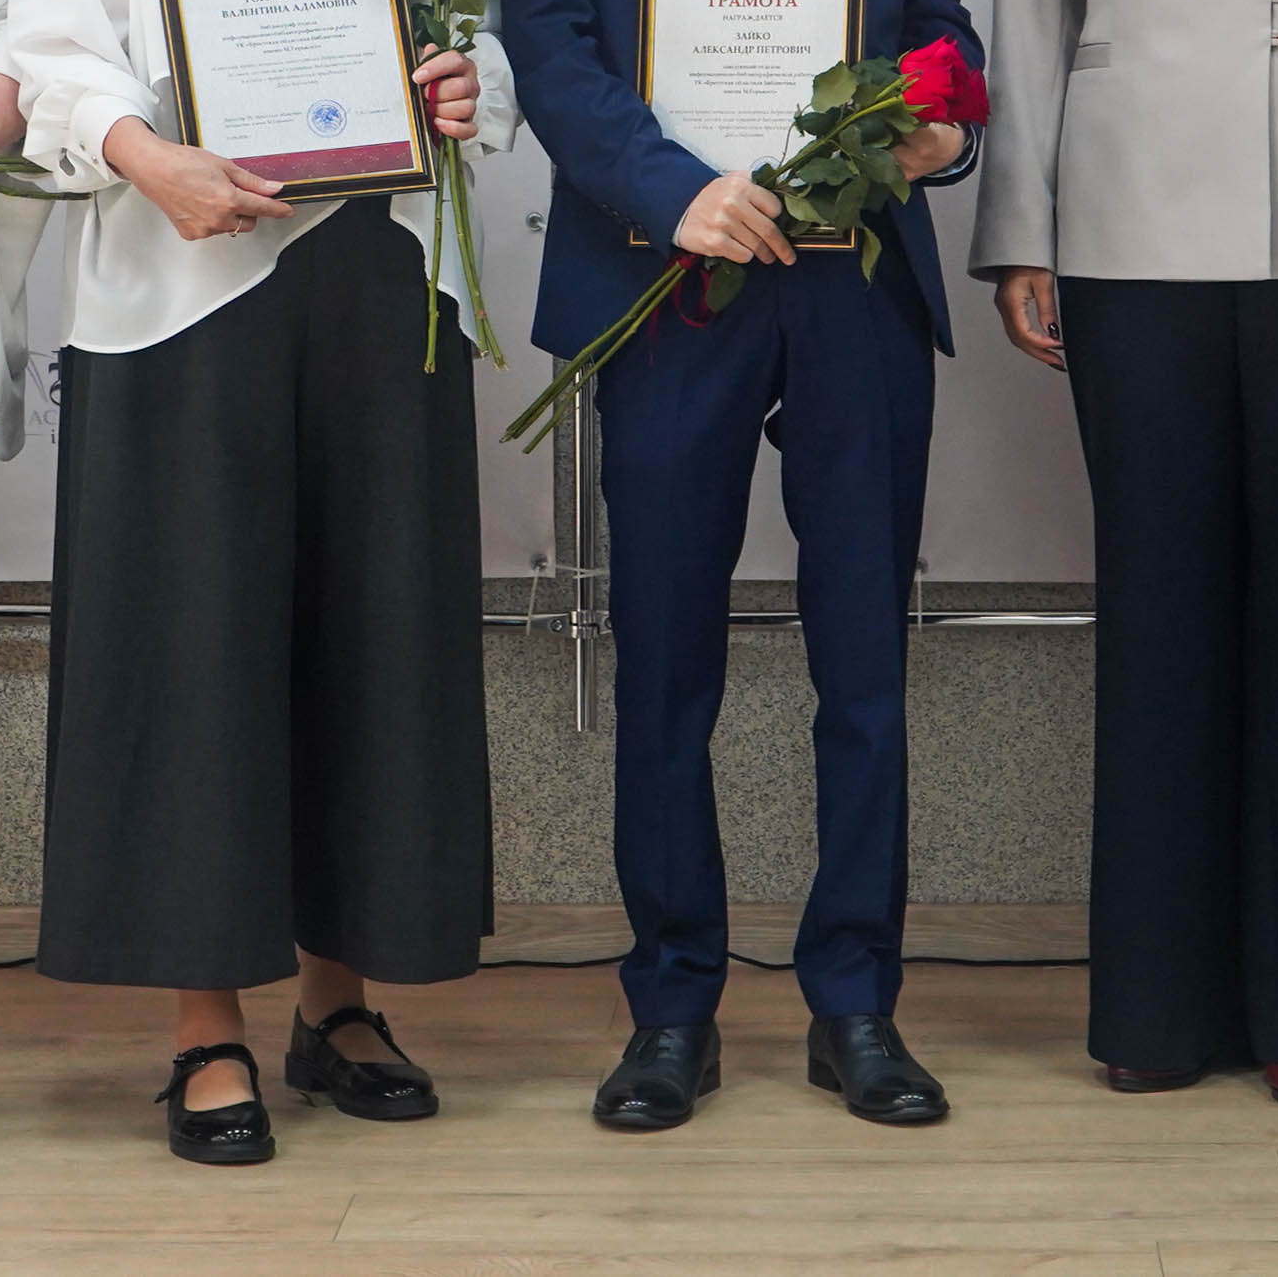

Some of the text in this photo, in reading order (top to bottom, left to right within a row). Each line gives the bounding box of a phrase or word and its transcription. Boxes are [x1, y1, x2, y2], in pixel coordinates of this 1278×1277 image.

[222, 4, 290, 18] ВАЛЕНТИНА
[736, 29, 771, 40] ЗАЙКО
[693, 45, 811, 55] АЛЕКСАНДР ПЕТРОВИЧ
